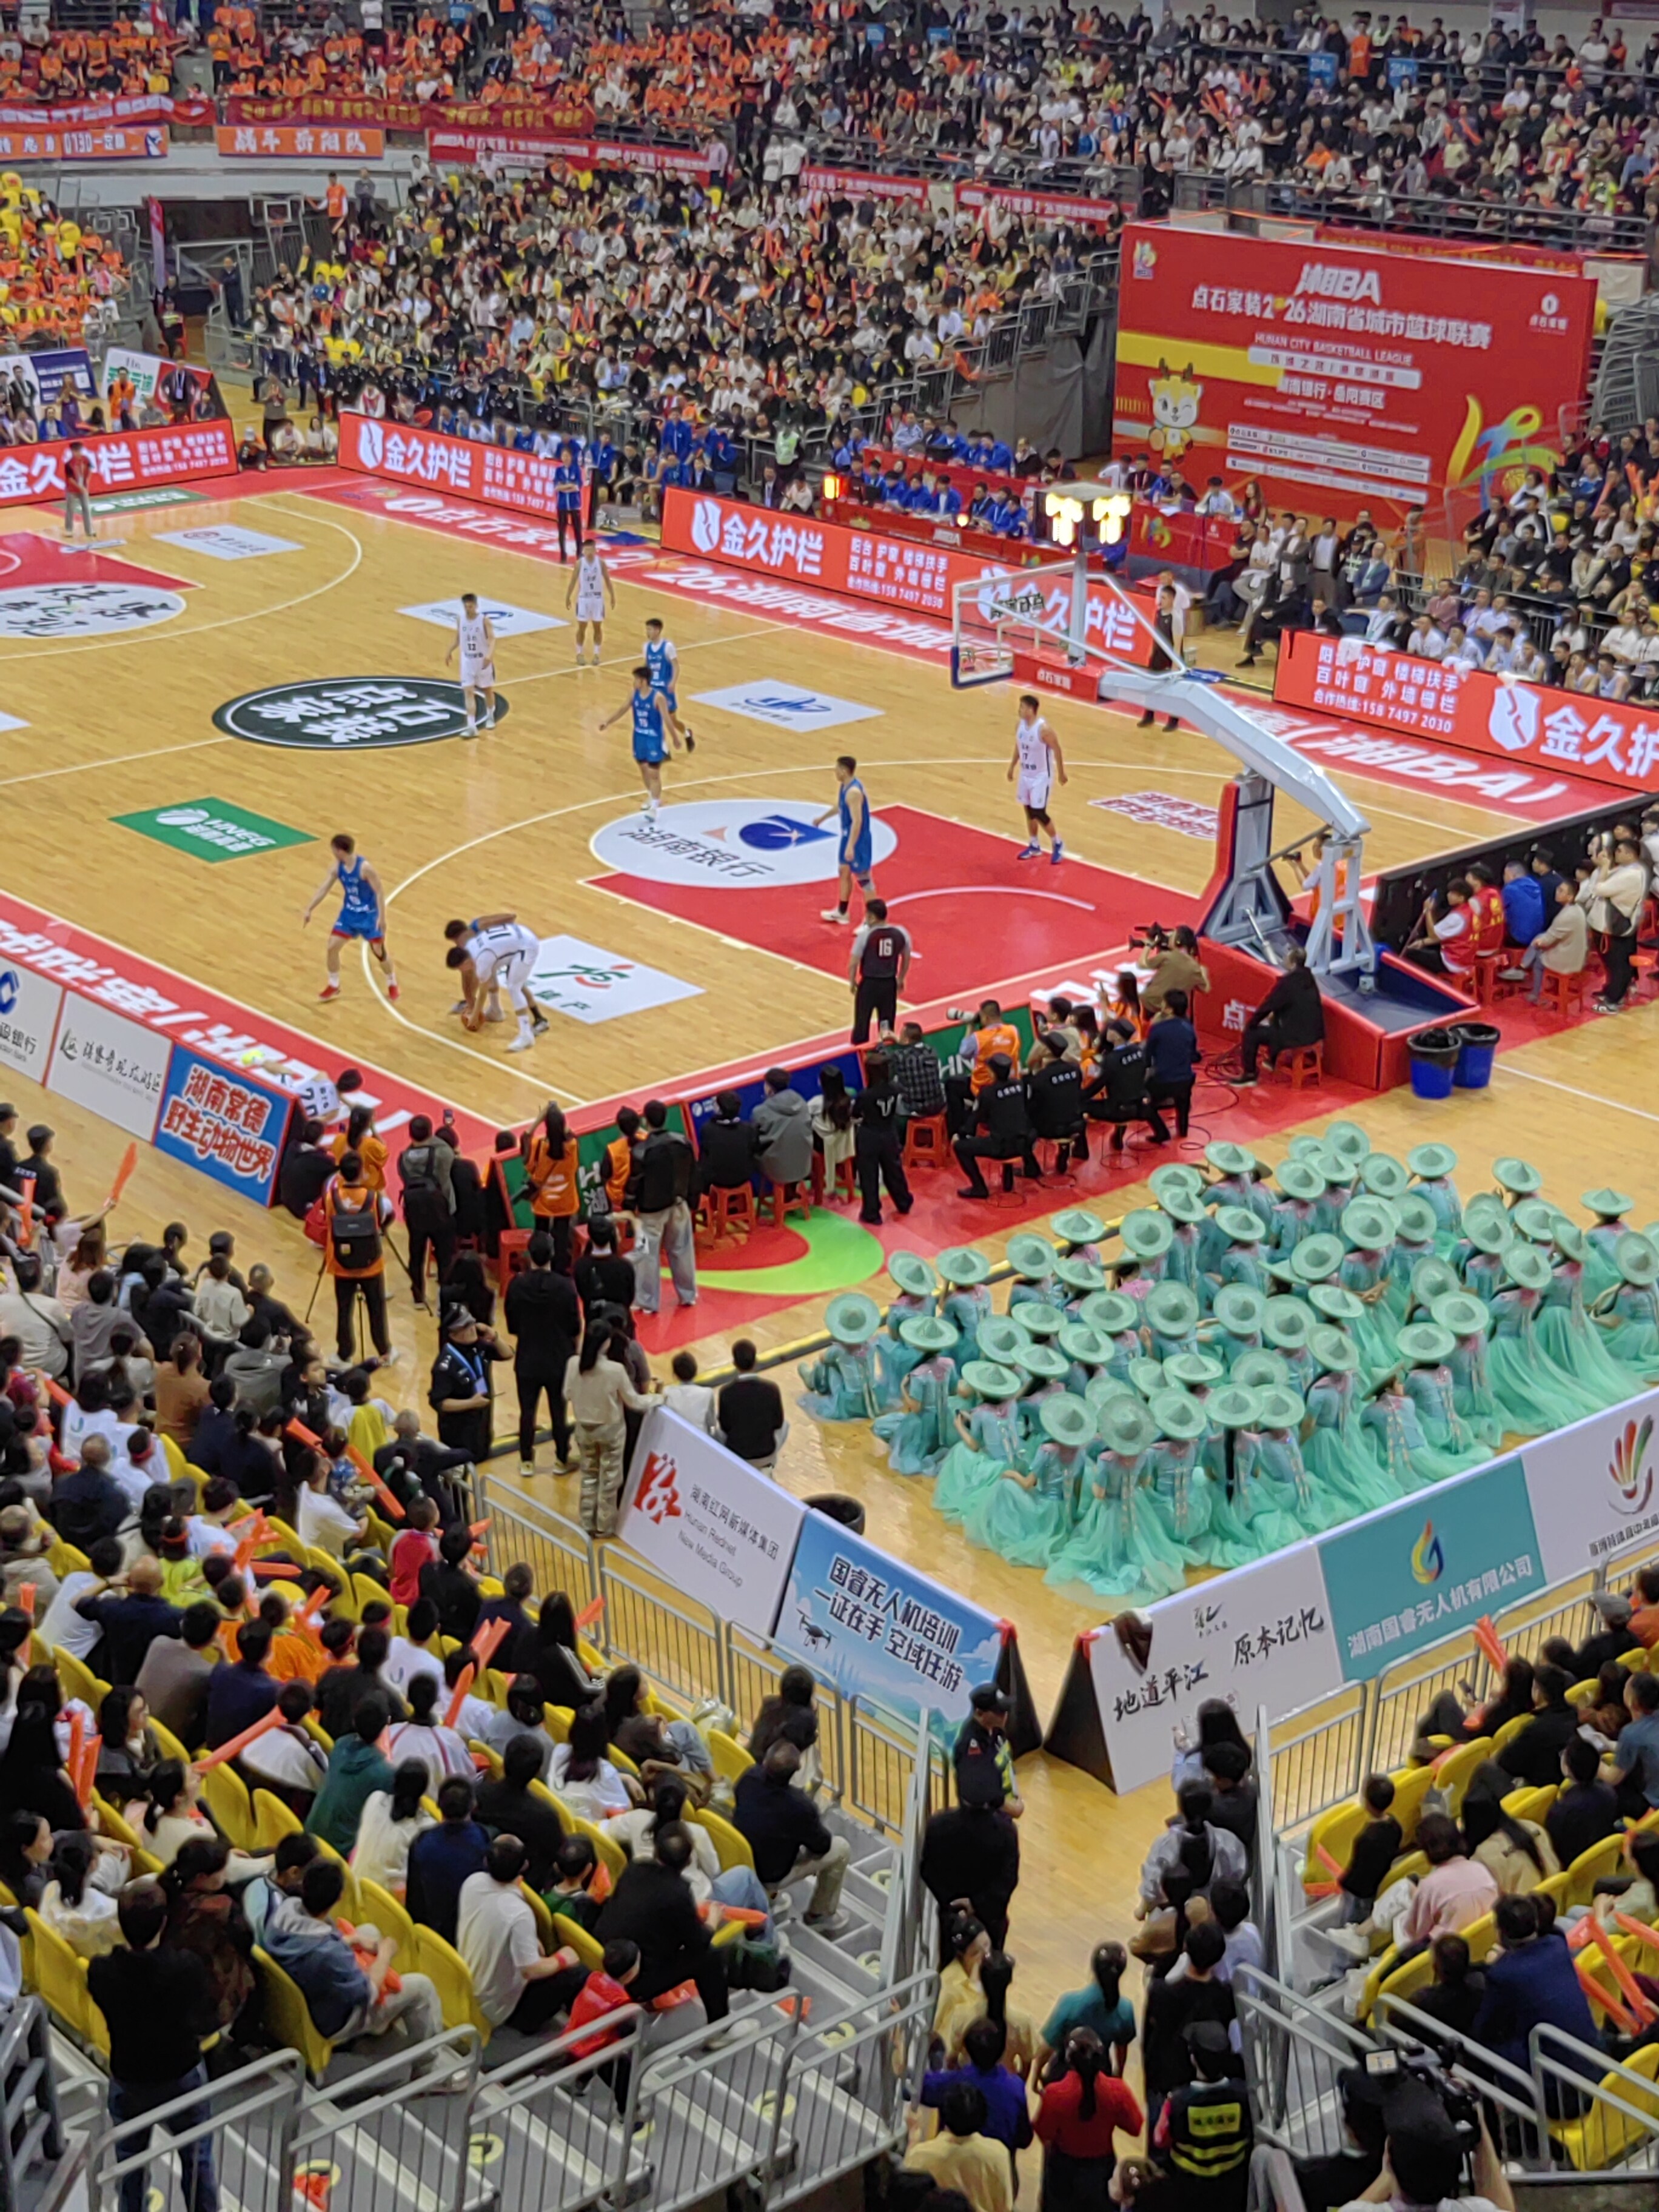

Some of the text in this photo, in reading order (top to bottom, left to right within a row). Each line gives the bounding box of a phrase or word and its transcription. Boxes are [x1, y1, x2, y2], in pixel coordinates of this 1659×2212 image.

[384, 432, 472, 487] 金久护栏
[721, 514, 823, 575] 金久护栏
[849, 554, 886, 578] 百叶窗
[851, 537, 948, 574] 阳台 护窗 楼梯扶手
[921, 591, 943, 610] 2030
[1316, 665, 1456, 713] 百叶窗 外墙栅栏
[1356, 654, 1384, 676] 护窗
[1394, 662, 1460, 692] 楼梯扶手
[1387, 705, 1419, 725] 7497
[1421, 714, 1452, 734] 2030
[1540, 705, 1659, 778] 金久护
[618, 826, 776, 879] 湖南银行
[878, 938, 893, 956] 16
[184, 1065, 271, 1136] 湖南常德
[163, 1096, 275, 1182] 野生动物世界
[678, 1529, 743, 1588] New Media Group
[829, 1556, 962, 1655] 国睿无人机培训
[1347, 1553, 1533, 1658] 湖南国睿无人机有限公司
[814, 1587, 964, 1693] 一证在手 空域任游
[1113, 1607, 1325, 1722] 地道平江 原本记忆
